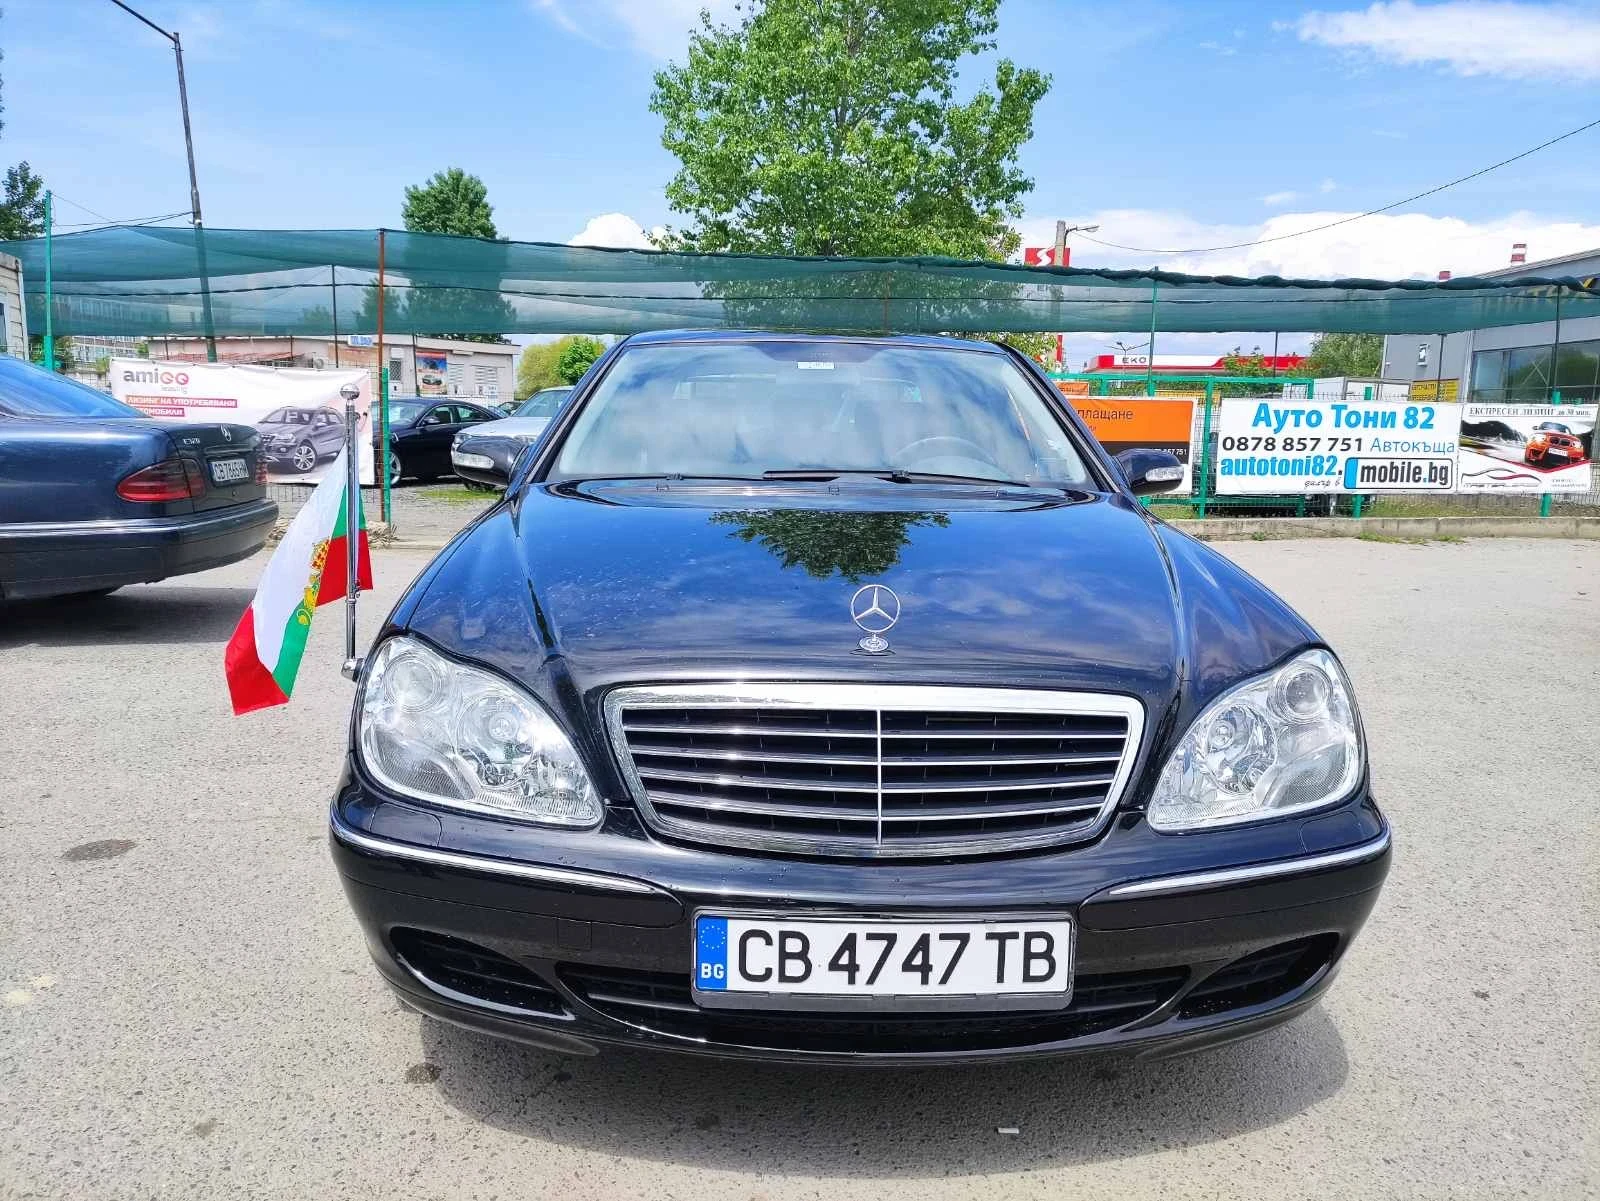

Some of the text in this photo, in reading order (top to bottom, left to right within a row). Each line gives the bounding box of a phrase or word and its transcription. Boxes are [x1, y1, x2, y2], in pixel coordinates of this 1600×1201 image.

[1252, 403, 1435, 434] Ауто Тони 82
[1469, 407, 1519, 416] ЕКСПРЕСЕН
[1222, 436, 1455, 455] 0878 857 751 Автокъща
[1360, 461, 1449, 485] mobile.bg
[738, 928, 1057, 986] CB 4747 TB
[701, 962, 725, 979] BG
